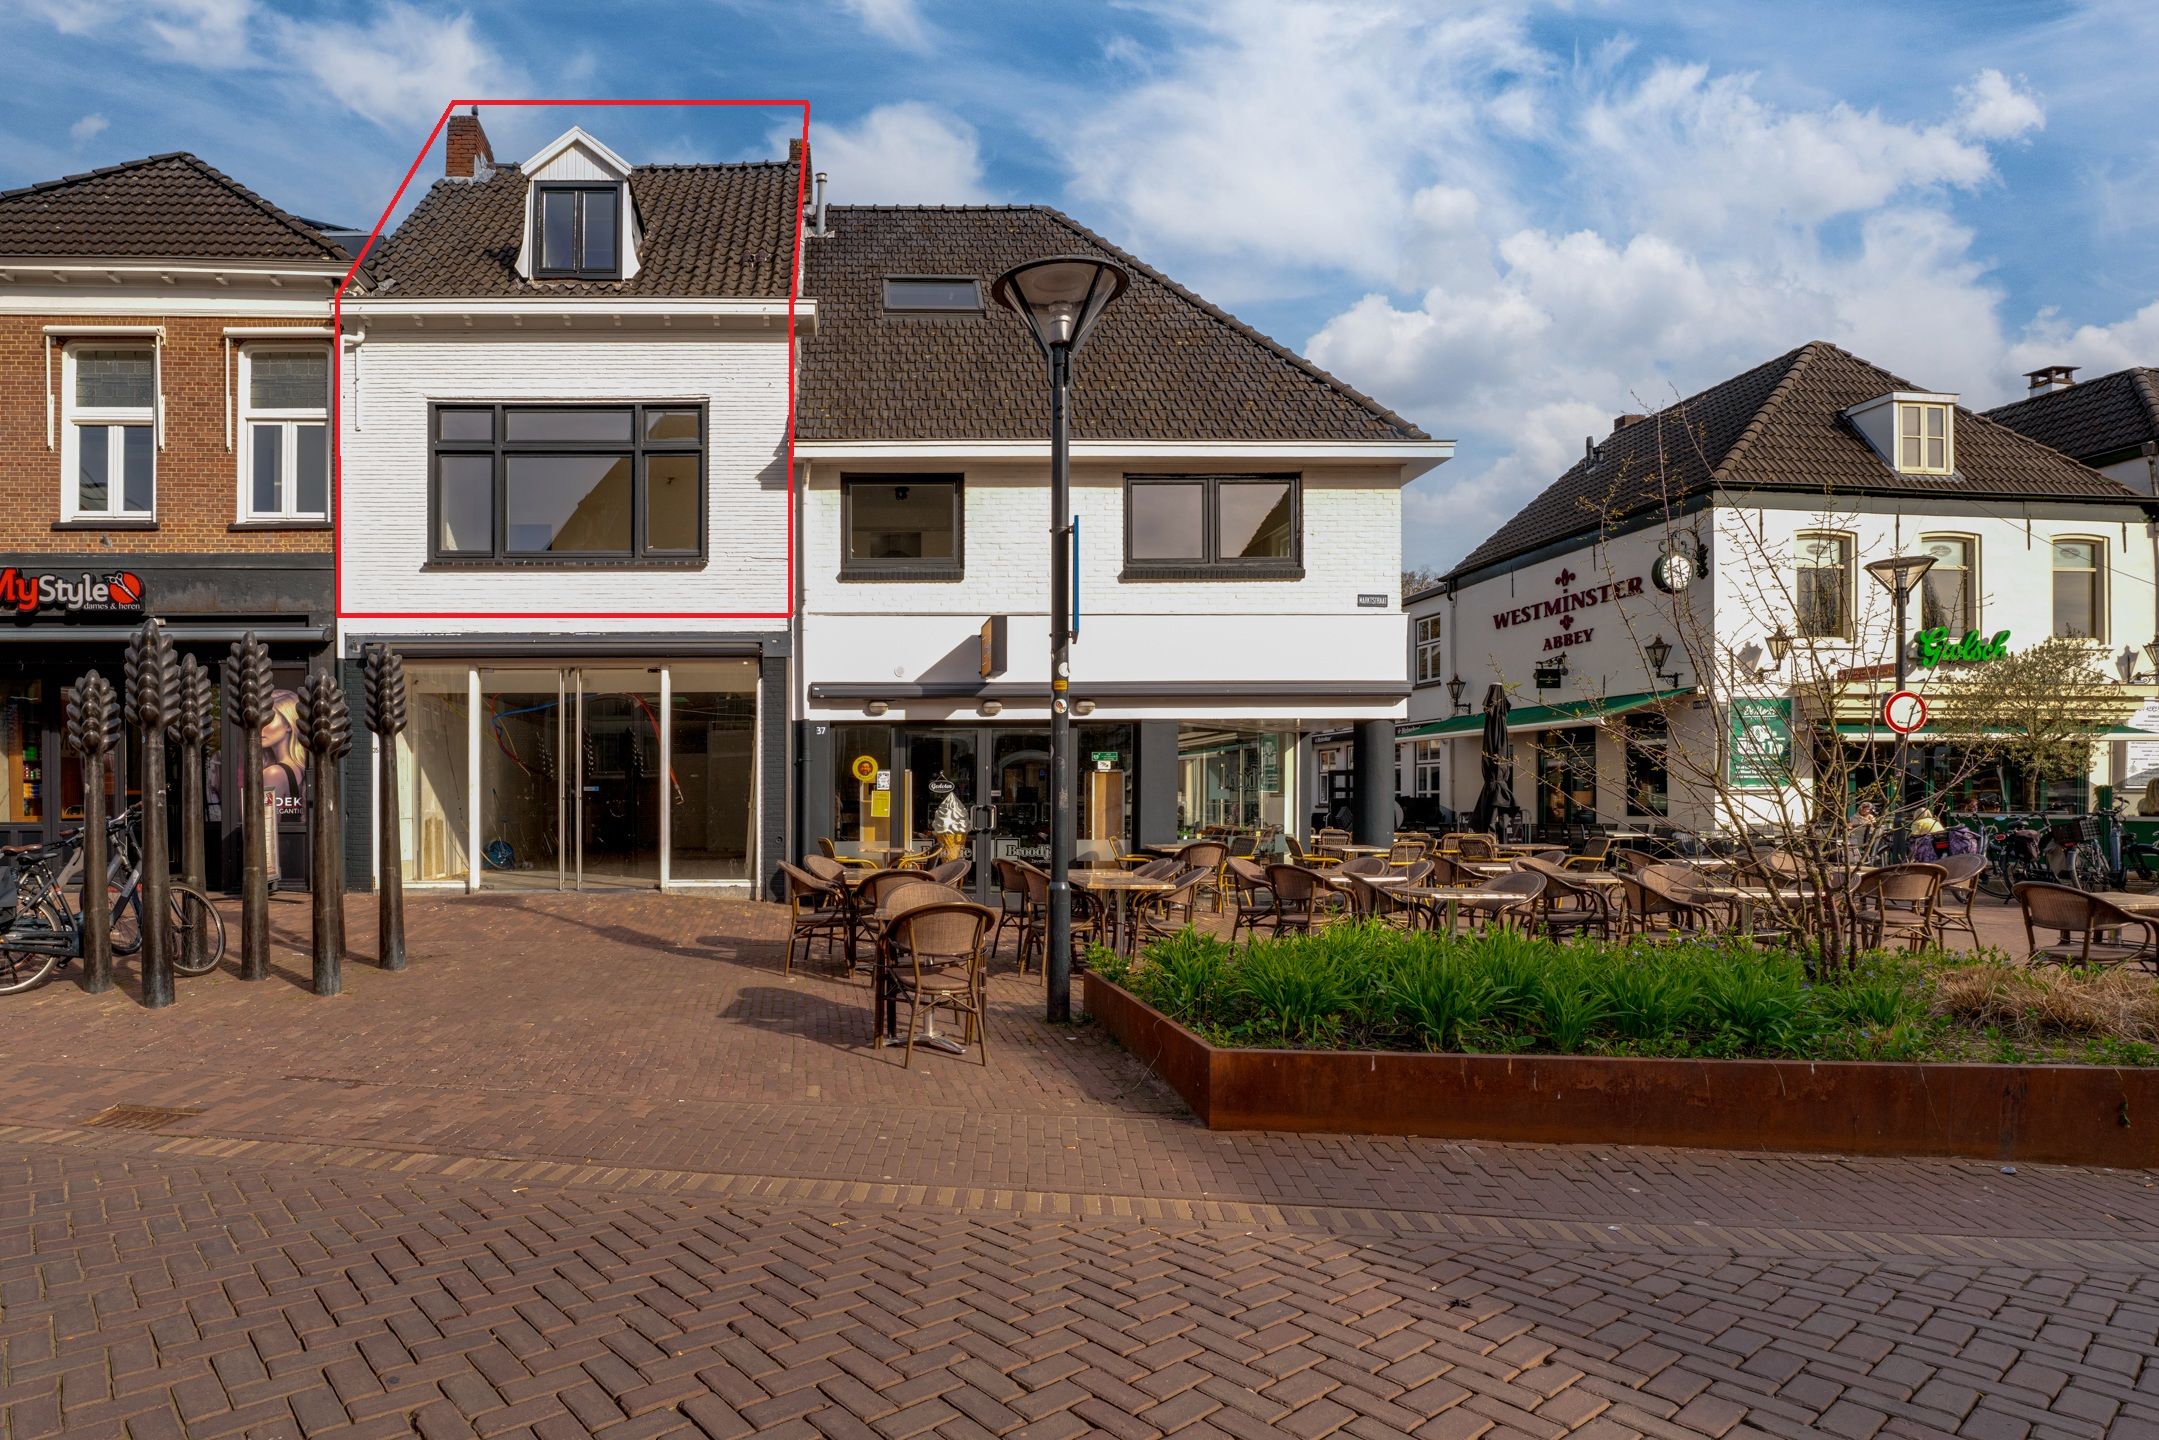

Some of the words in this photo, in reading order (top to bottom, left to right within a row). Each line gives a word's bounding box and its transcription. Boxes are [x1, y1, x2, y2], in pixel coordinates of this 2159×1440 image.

[0, 567, 109, 611] MyStyle
[1493, 576, 1644, 630] WESTMINSTER
[83, 602, 108, 610] dames
[110, 602, 117, 610] &
[118, 602, 140, 610] heren
[1542, 628, 1595, 651] ABBEY
[1919, 626, 2011, 667] Grolsch
[816, 727, 826, 735] 37
